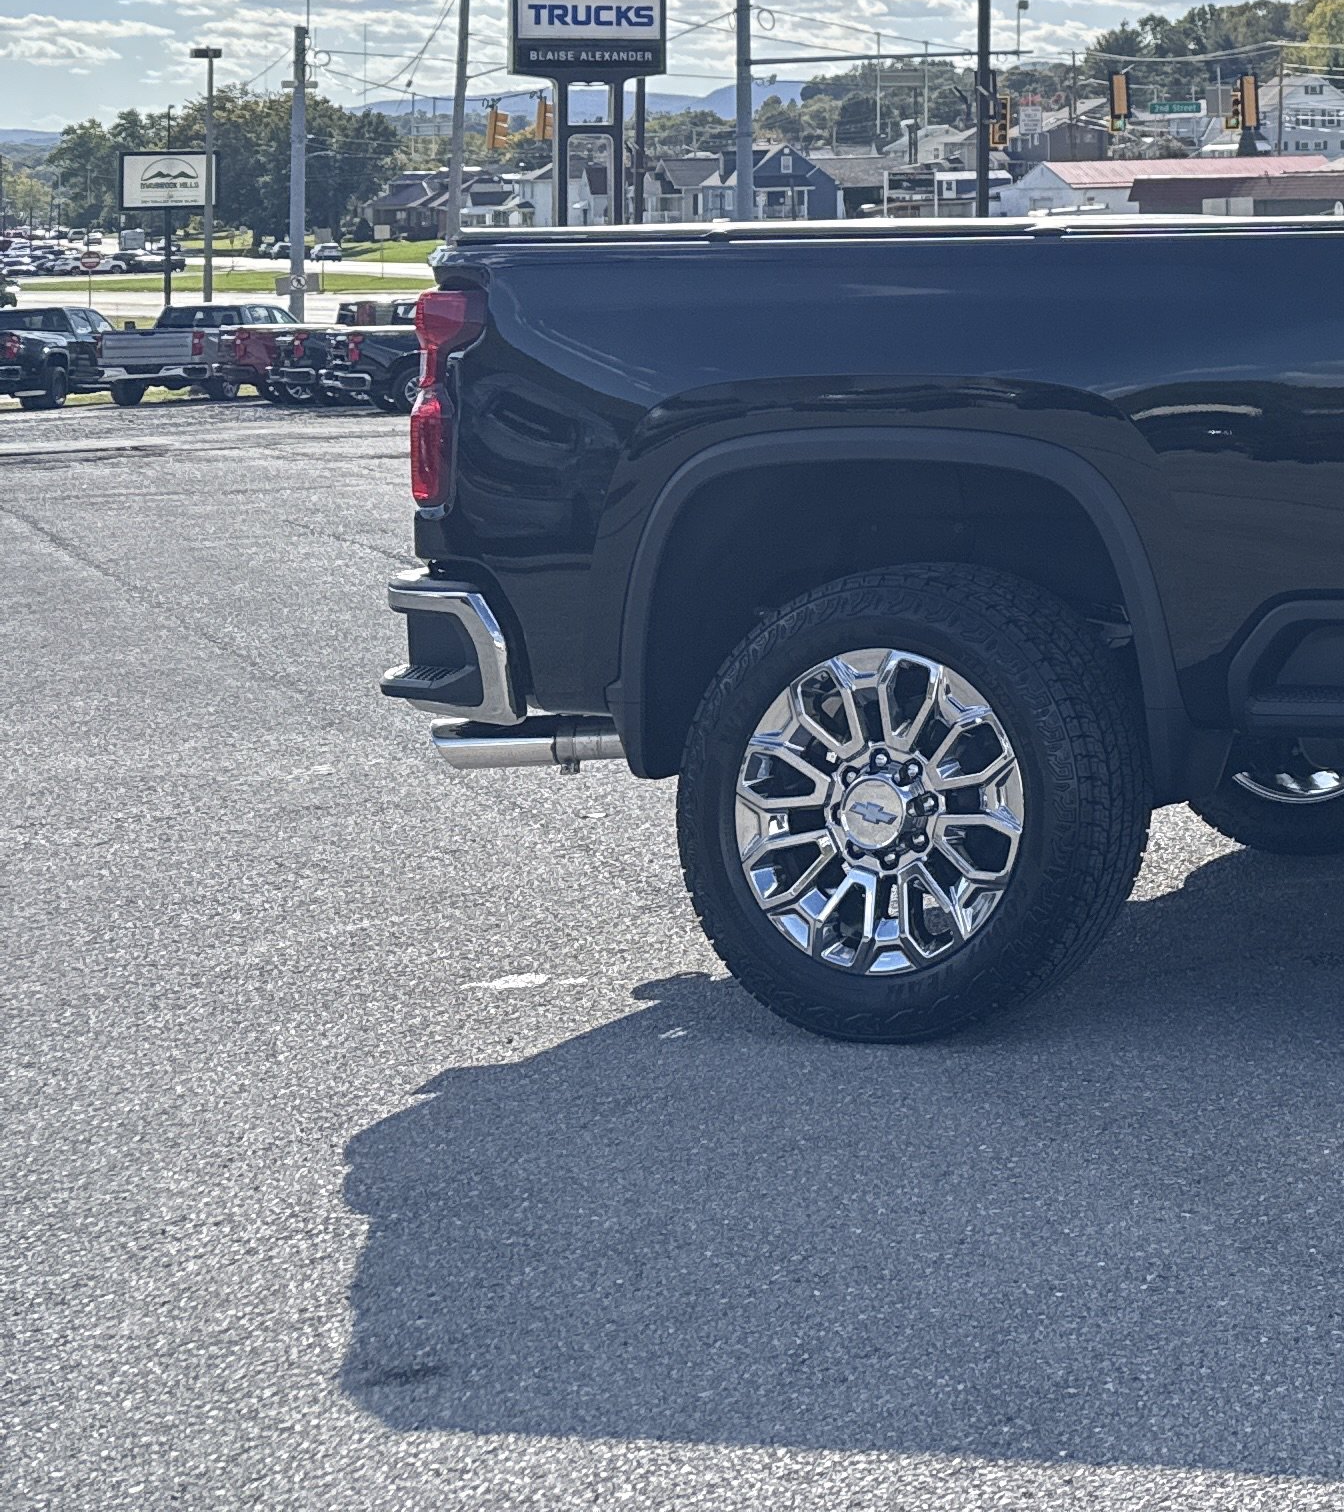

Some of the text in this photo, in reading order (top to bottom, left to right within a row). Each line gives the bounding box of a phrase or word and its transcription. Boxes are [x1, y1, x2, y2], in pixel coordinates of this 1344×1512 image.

[527, 3, 655, 27] TRUCKS
[529, 50, 653, 62] BLAISE ALEXANDER
[1172, 103, 1197, 113] Street
